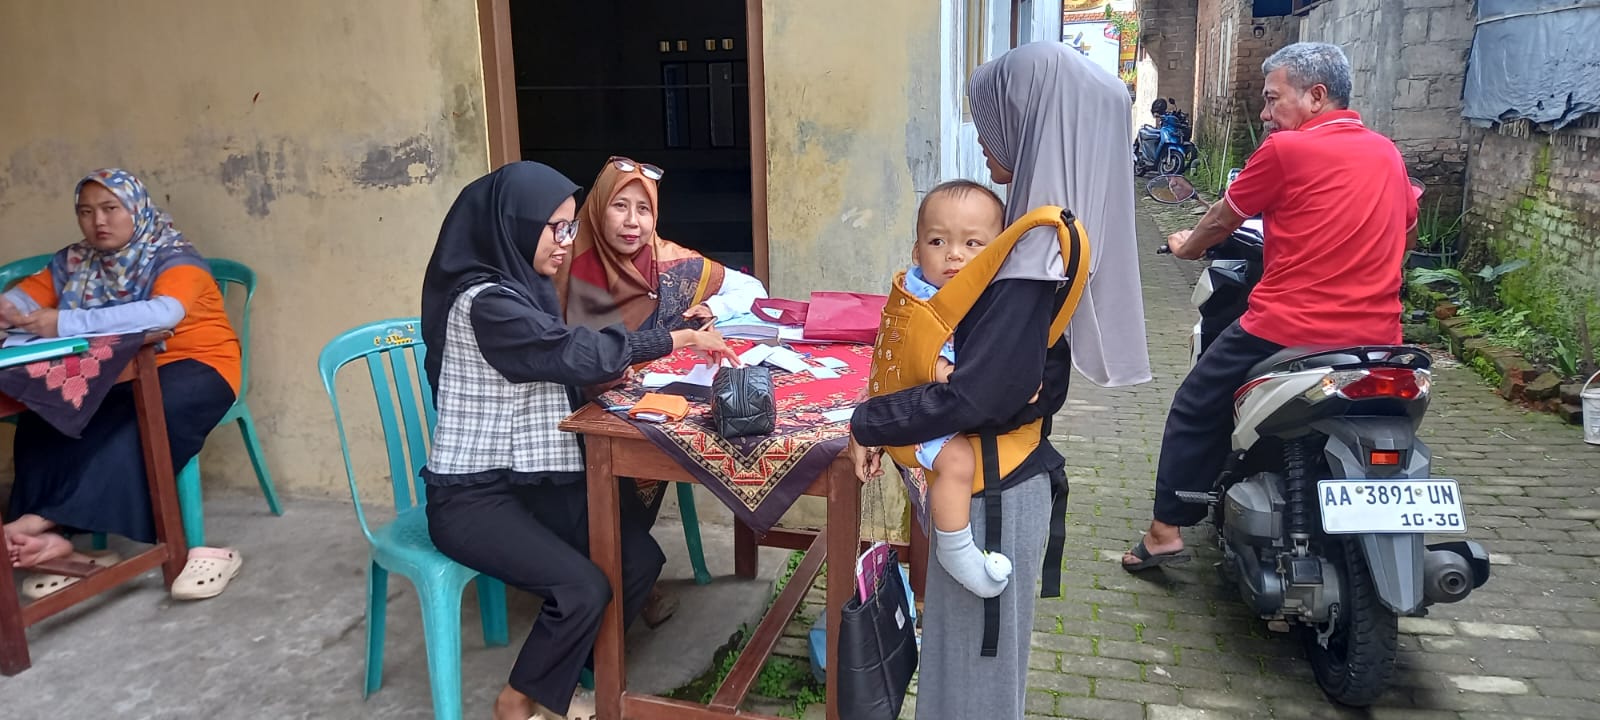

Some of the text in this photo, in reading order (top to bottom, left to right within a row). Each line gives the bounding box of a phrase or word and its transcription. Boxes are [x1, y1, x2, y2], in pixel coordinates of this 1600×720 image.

[1325, 485, 1455, 506] AA 3891 UN
